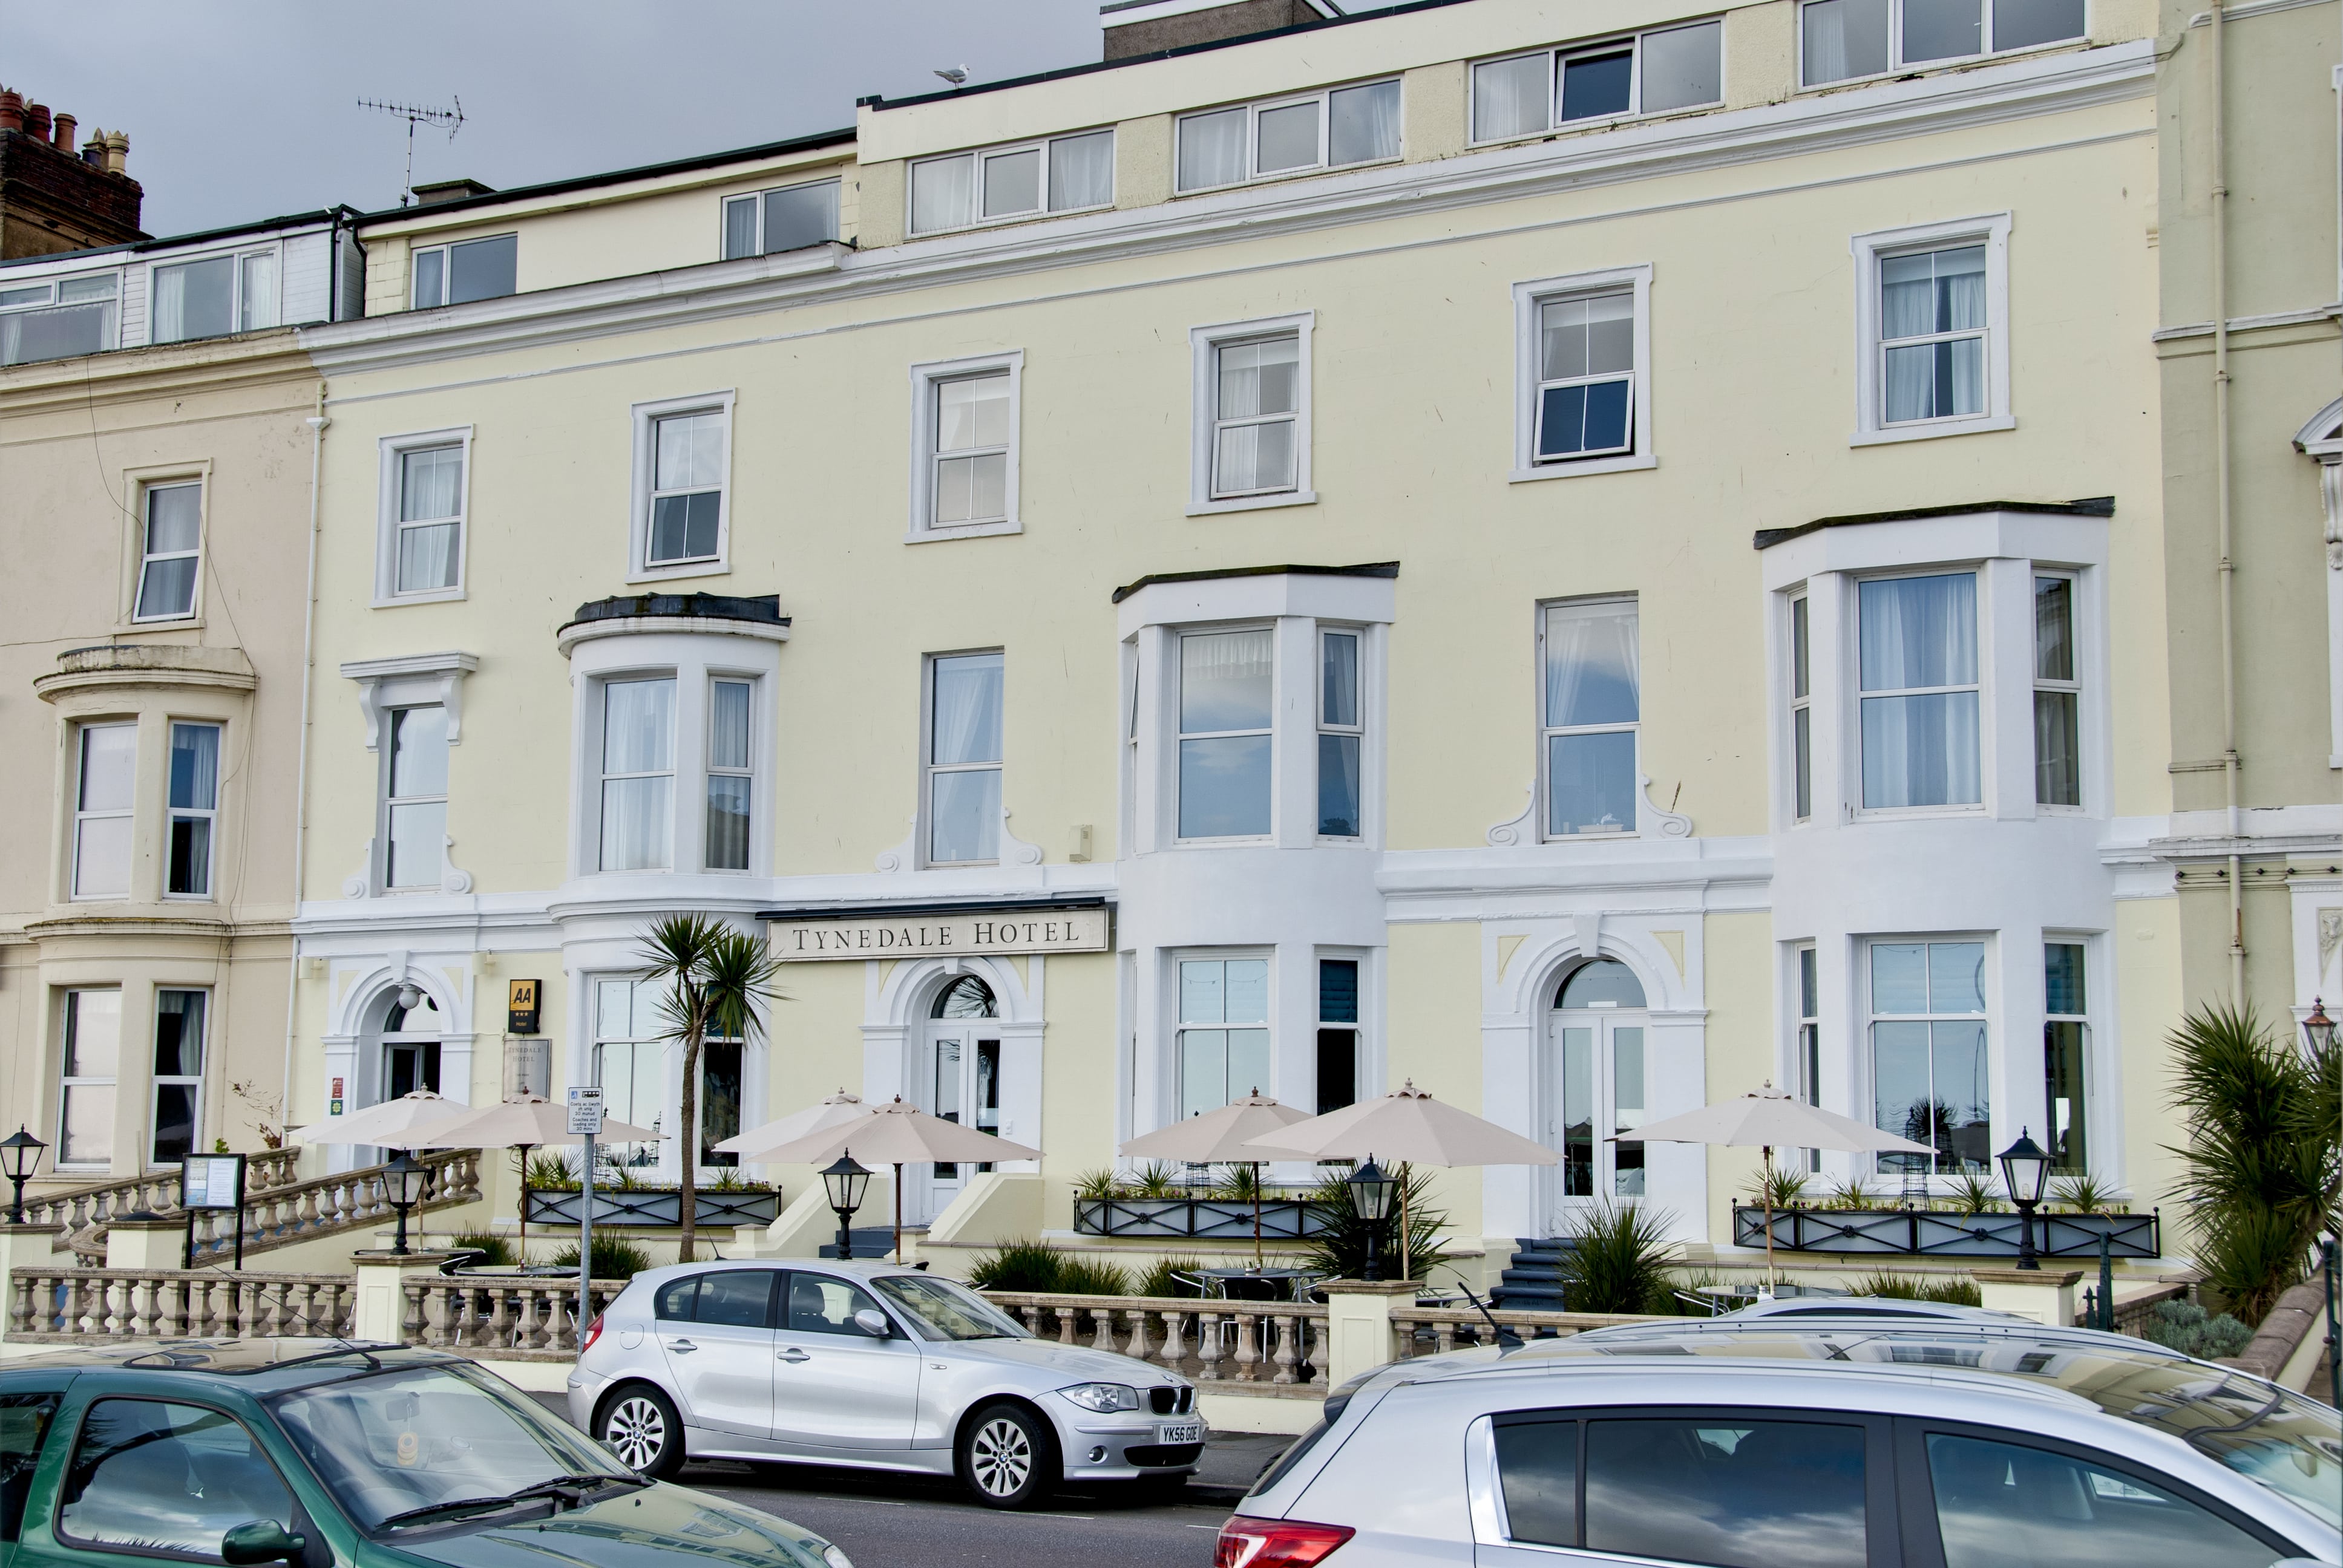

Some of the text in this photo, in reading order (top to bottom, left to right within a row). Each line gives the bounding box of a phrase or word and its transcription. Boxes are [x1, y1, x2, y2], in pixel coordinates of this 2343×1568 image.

[793, 921, 1080, 950] TYNEDALE HOTEL
[514, 988, 531, 1003] AA
[1164, 1426, 1197, 1442] YK56 GOE
